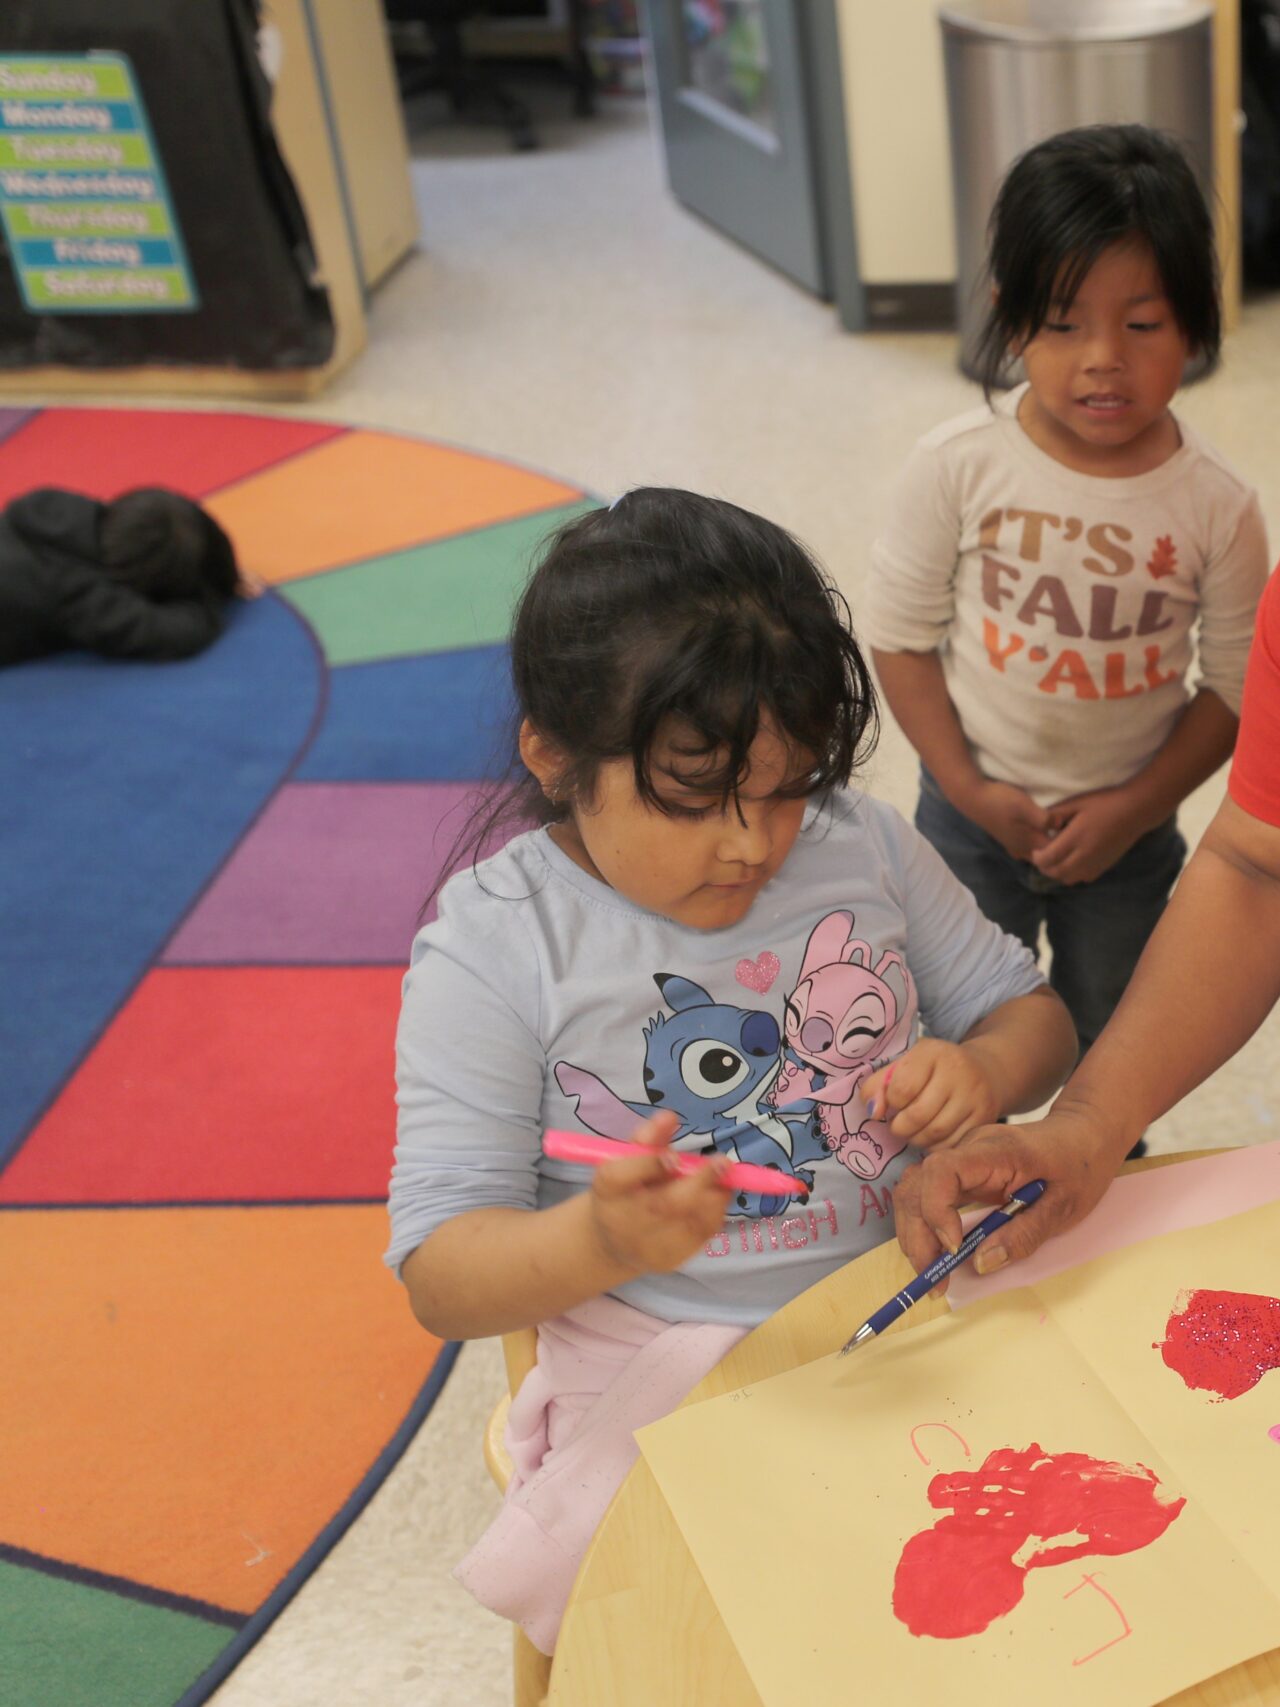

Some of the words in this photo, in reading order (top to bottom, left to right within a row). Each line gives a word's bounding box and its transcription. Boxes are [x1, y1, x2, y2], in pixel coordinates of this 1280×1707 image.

[0, 64, 97, 97] Sunday
[2, 101, 112, 132] Monday
[11, 135, 123, 166] Tuesday
[2, 171, 154, 200] Wednesday
[27, 204, 148, 233] Thursday
[53, 239, 142, 268] Friday
[44, 271, 168, 301] Saturday
[978, 506, 1135, 578] IT'S
[981, 553, 1175, 641] FALL
[982, 614, 1178, 700] Y'ALL
